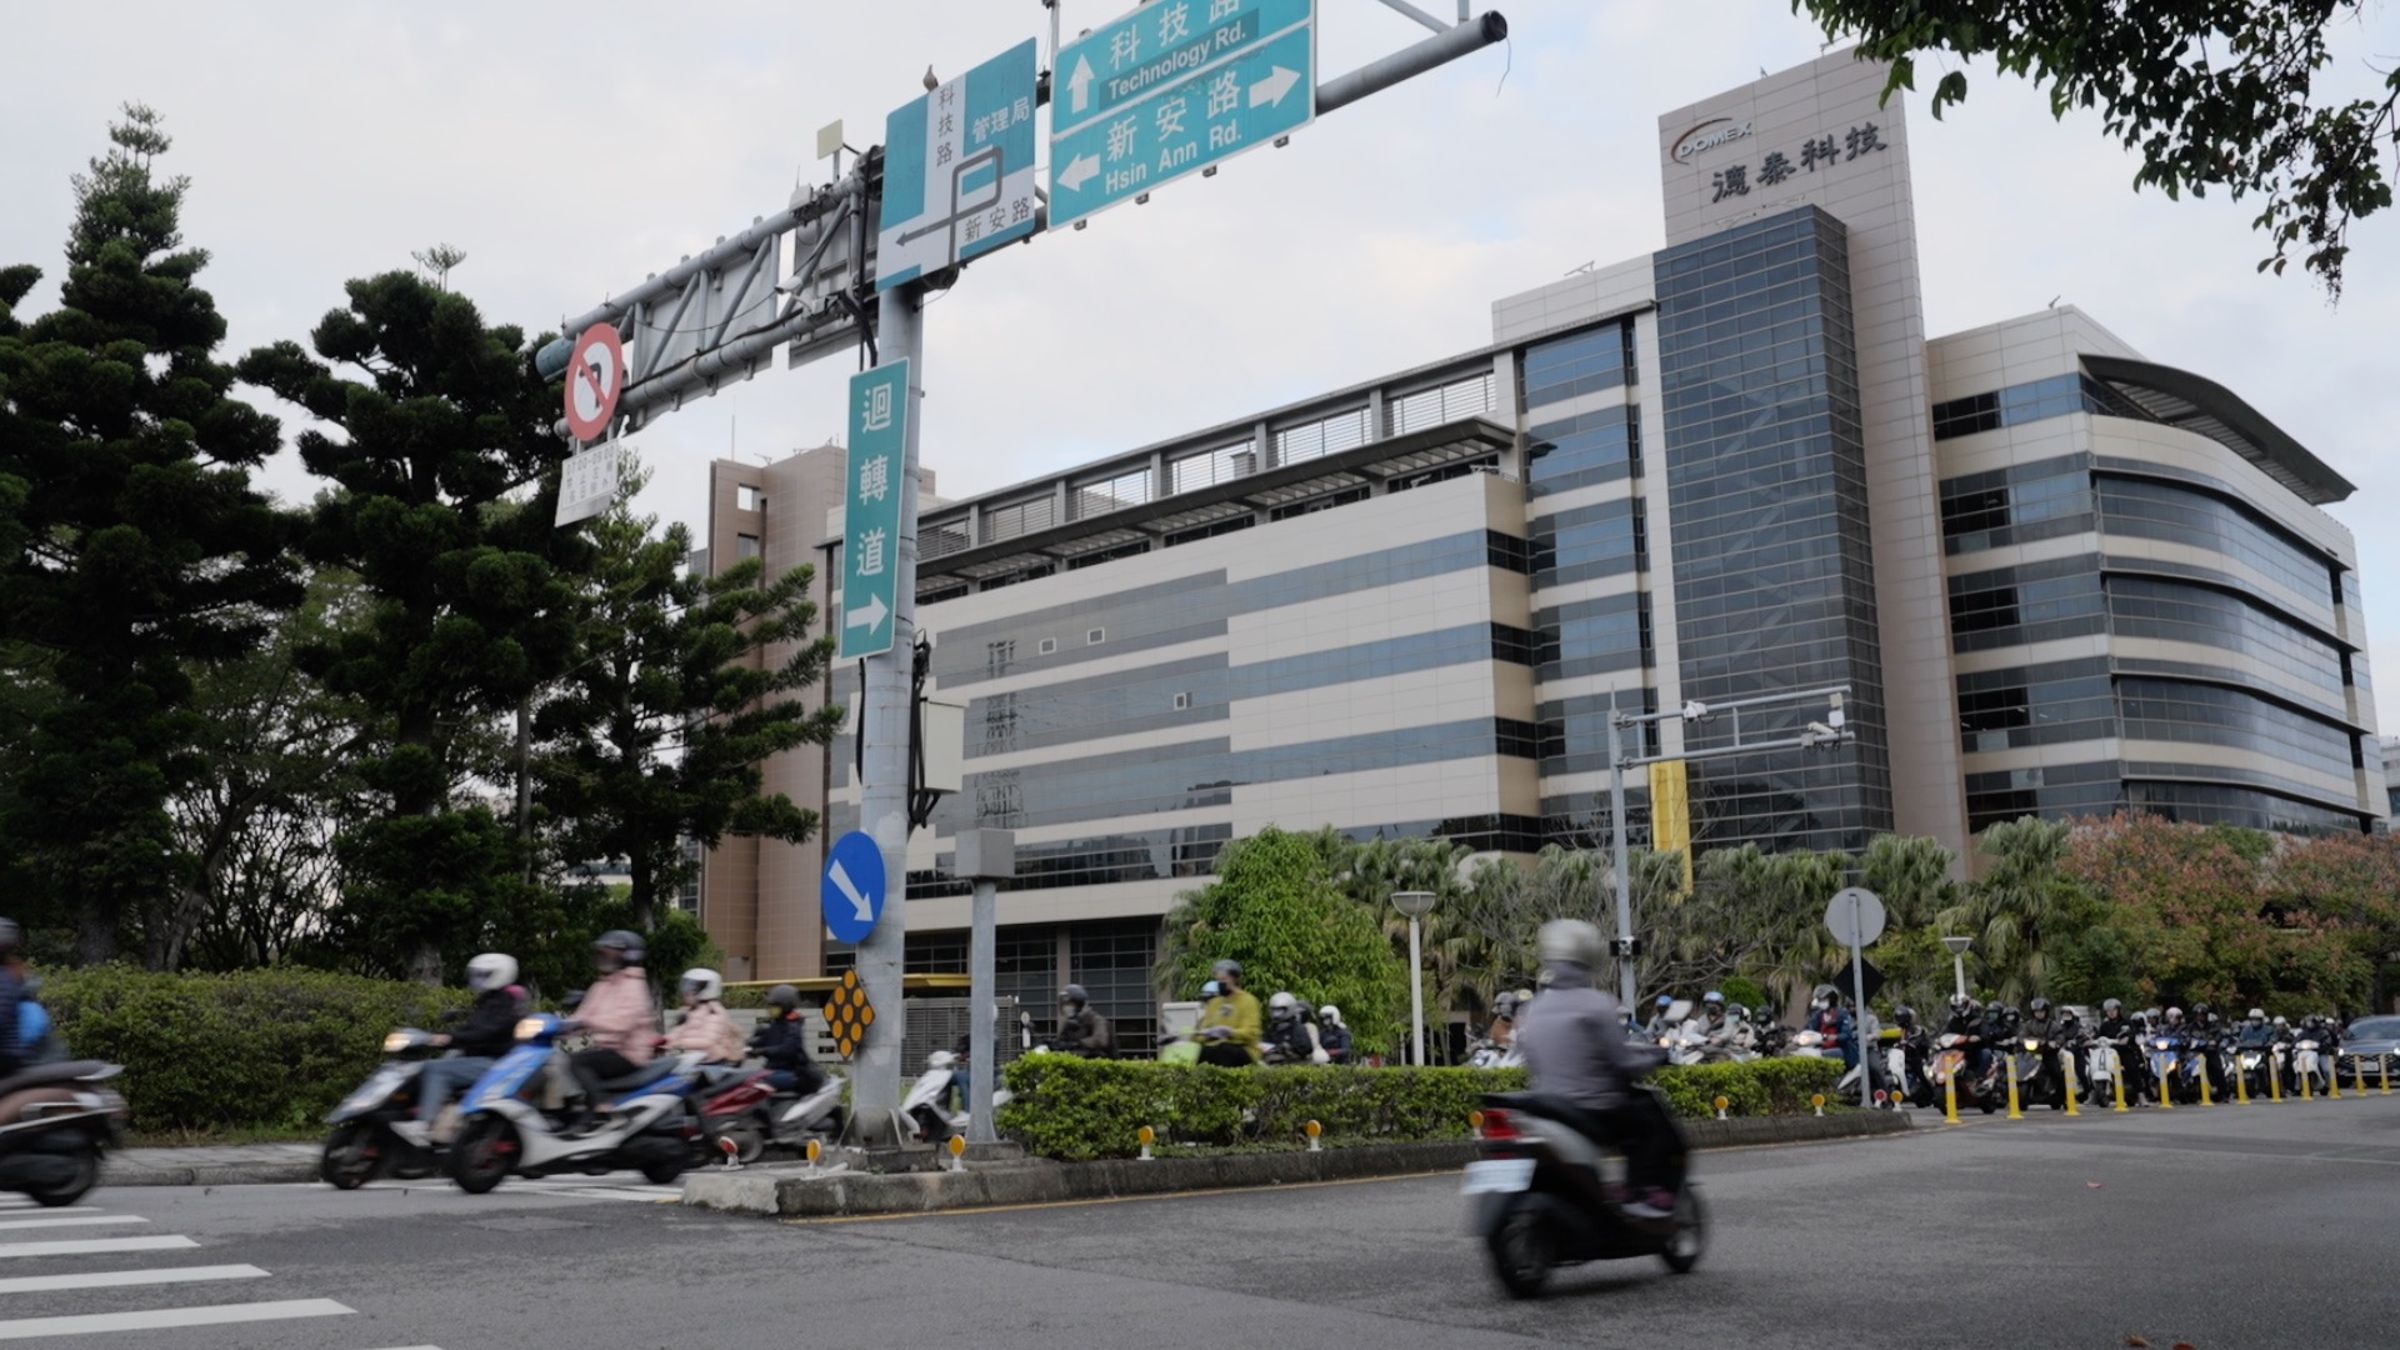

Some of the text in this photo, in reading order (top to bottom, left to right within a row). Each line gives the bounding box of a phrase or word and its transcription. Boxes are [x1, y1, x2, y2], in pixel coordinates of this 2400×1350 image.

[1108, 20, 1246, 100] Technology Rd.
[936, 84, 954, 168] 科技路
[972, 96, 1030, 144] 管理局
[1106, 70, 1241, 163] 新安路
[1679, 122, 1752, 158] DOMEX
[1105, 118, 1242, 195] Hsin Ann Rd.
[965, 196, 1030, 242] 新安路
[856, 382, 892, 577] 迴轉道
